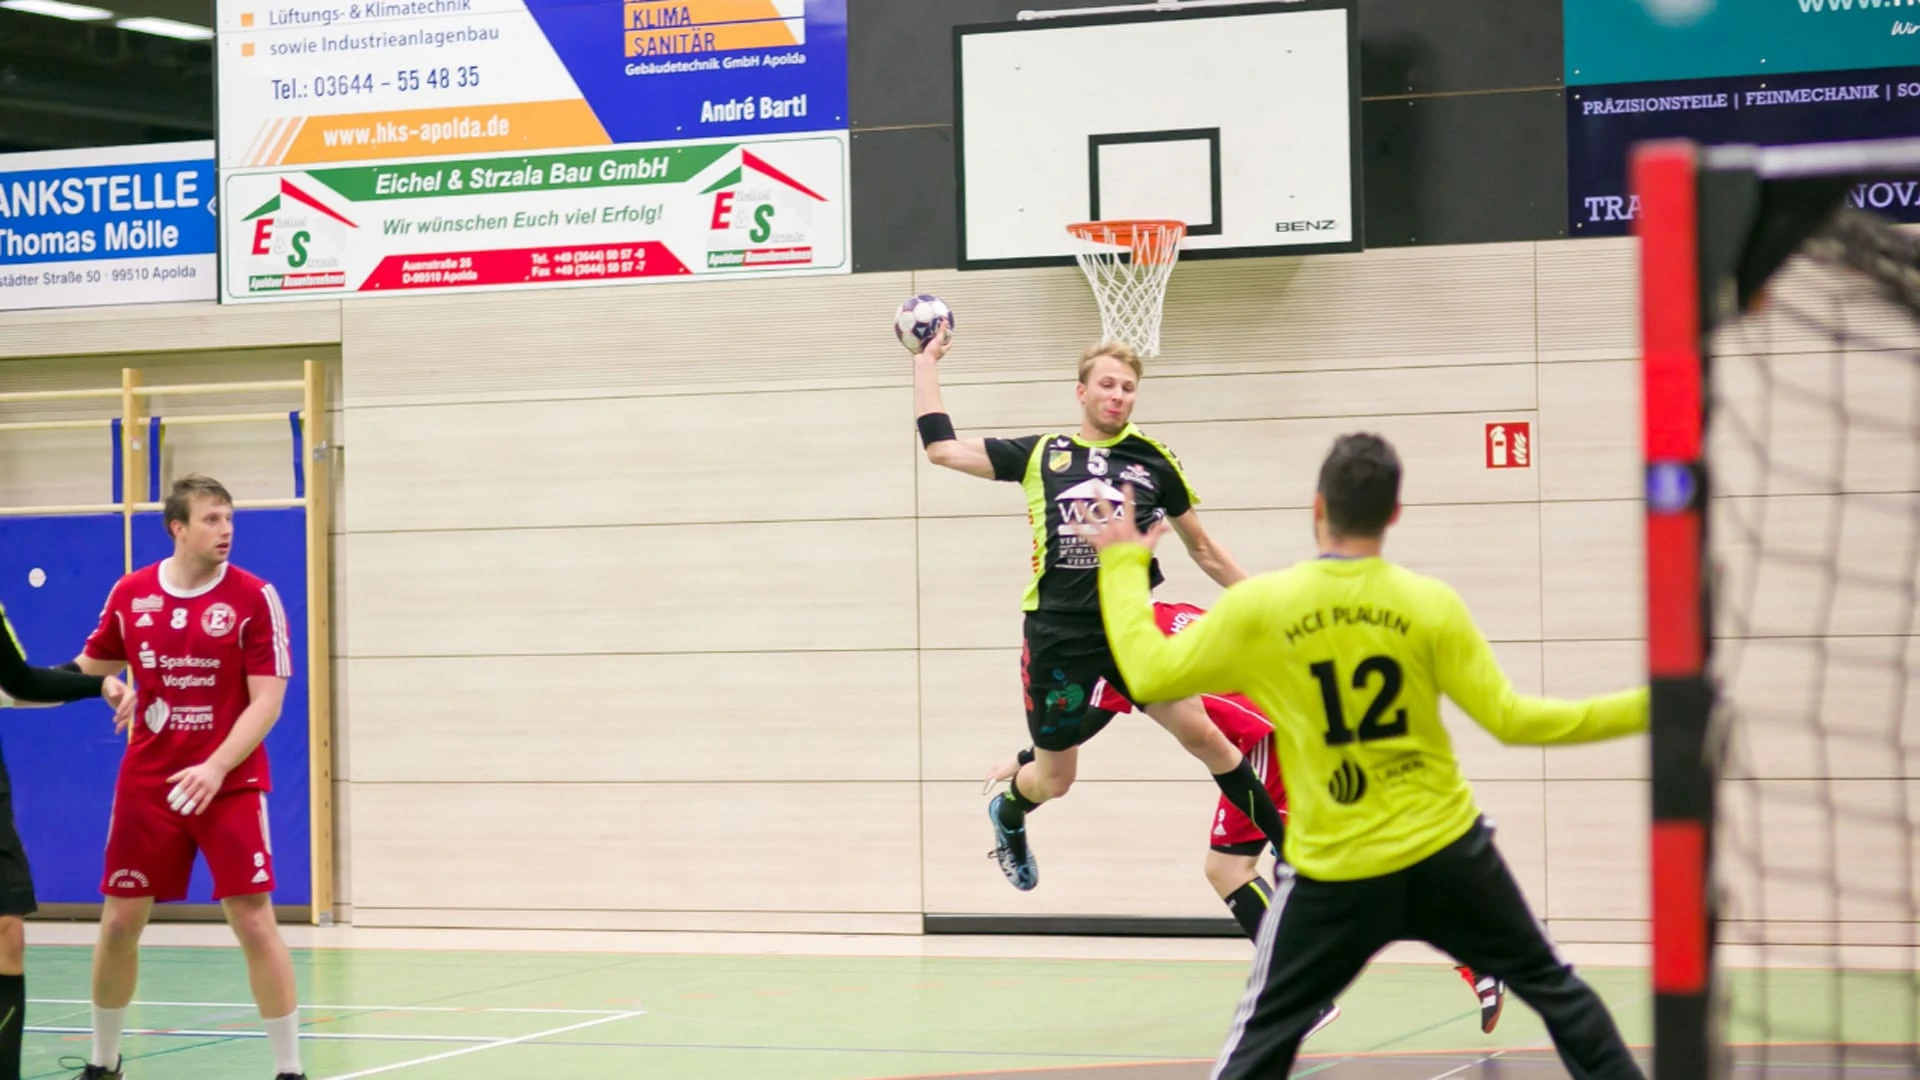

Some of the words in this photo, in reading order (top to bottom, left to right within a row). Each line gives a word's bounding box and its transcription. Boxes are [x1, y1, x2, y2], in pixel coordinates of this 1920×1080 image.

[269, 8, 345, 26] Lüftungs-
[350, 4, 361, 18] &
[365, 0, 472, 18] Klimatechnik
[633, 6, 692, 29] KLIMA
[269, 38, 317, 56] sowie
[322, 26, 499, 52] Industrieanlagenbau
[633, 27, 716, 56] SANITÄR
[625, 58, 720, 76] Gebäudetechnik
[722, 55, 760, 70] GmbH
[763, 52, 806, 68] Apolda
[272, 79, 308, 100] Tel.:
[314, 73, 373, 97] 03644
[398, 70, 419, 91] 55
[426, 67, 450, 89] 48
[457, 66, 479, 87] 35
[700, 96, 755, 123] André
[760, 94, 807, 119] Bartl
[1582, 93, 1728, 115] PRÄZISIONSTEILE
[1745, 85, 1879, 106] FEINMECHANIK
[323, 115, 509, 147] www.hks-apolda.de
[375, 170, 443, 195] Eichel
[447, 172, 463, 190] &
[470, 165, 543, 190] Strzala
[549, 162, 593, 184] Bau
[599, 156, 669, 181] GmbH
[0, 171, 200, 218] ANKSTELLE
[1845, 181, 1920, 209] NOV
[383, 218, 413, 236] Wir
[418, 212, 507, 235] wünschen
[513, 209, 559, 229] Euch
[565, 206, 597, 226] viel
[603, 204, 664, 225] Erfolg!
[711, 191, 735, 230] E
[749, 203, 775, 243] S
[1275, 219, 1336, 232] BENZ
[0, 228, 97, 256] Thomas
[104, 219, 179, 252] Mölle
[252, 218, 275, 255] E
[287, 230, 311, 268] S
[531, 252, 549, 264] Tel.
[531, 265, 551, 277] Fax
[43, 271, 82, 286] Straße
[86, 270, 101, 283] 50
[112, 267, 149, 281] 99510
[152, 265, 196, 281] Apolda
[443, 269, 478, 283] Apolda
[1087, 446, 1111, 476] 5
[170, 607, 188, 629] 8
[1285, 610, 1328, 646] HCE
[1331, 606, 1411, 637] PLAUEN
[159, 654, 221, 670] Sparkasse
[162, 673, 216, 690] Vogtland
[1308, 654, 1409, 747] 12
[1218, 807, 1226, 822] 9
[253, 851, 265, 867] 8
